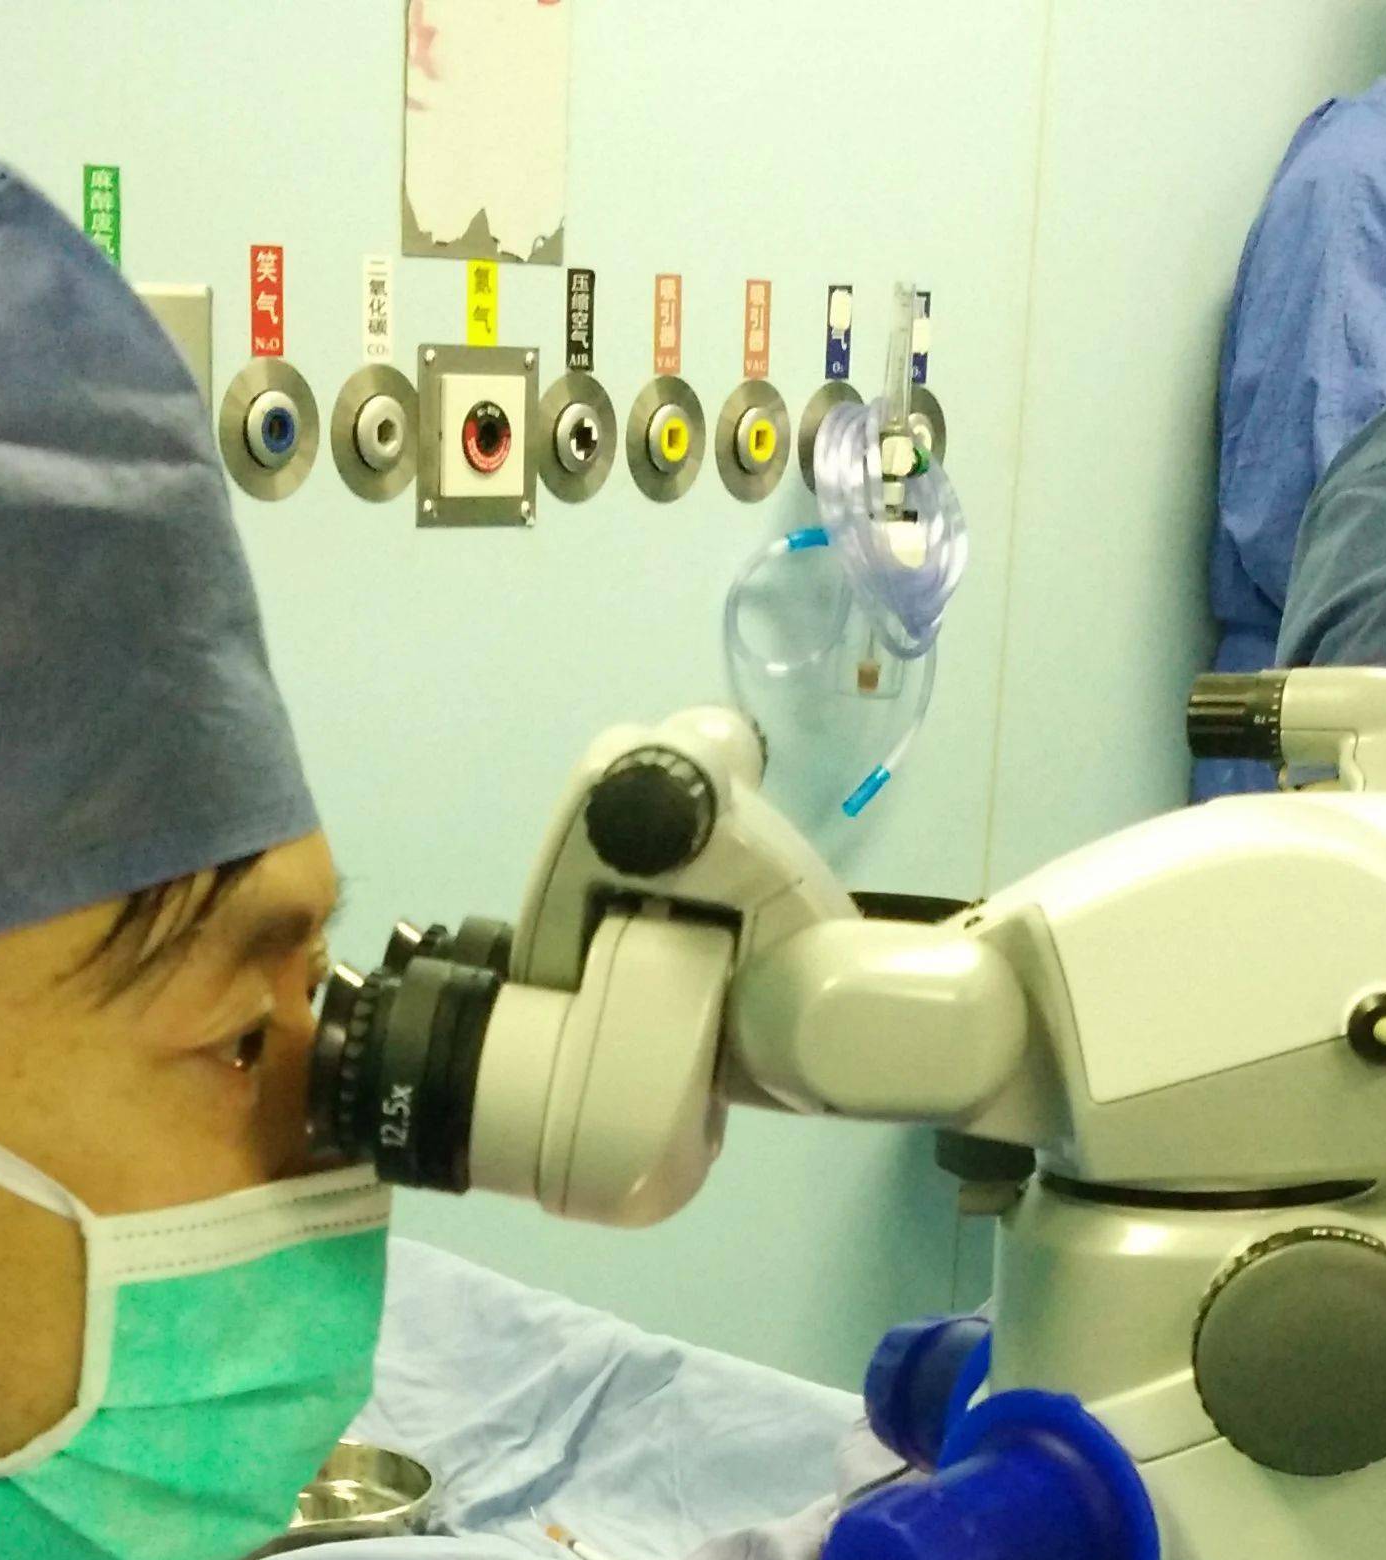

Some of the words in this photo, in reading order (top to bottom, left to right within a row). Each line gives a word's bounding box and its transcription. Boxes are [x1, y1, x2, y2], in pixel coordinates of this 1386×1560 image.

[255, 249, 279, 325] 笑气
[571, 273, 590, 349] 压缩空气
[568, 353, 590, 366] AIR
[379, 1084, 414, 1149] 12.5x
